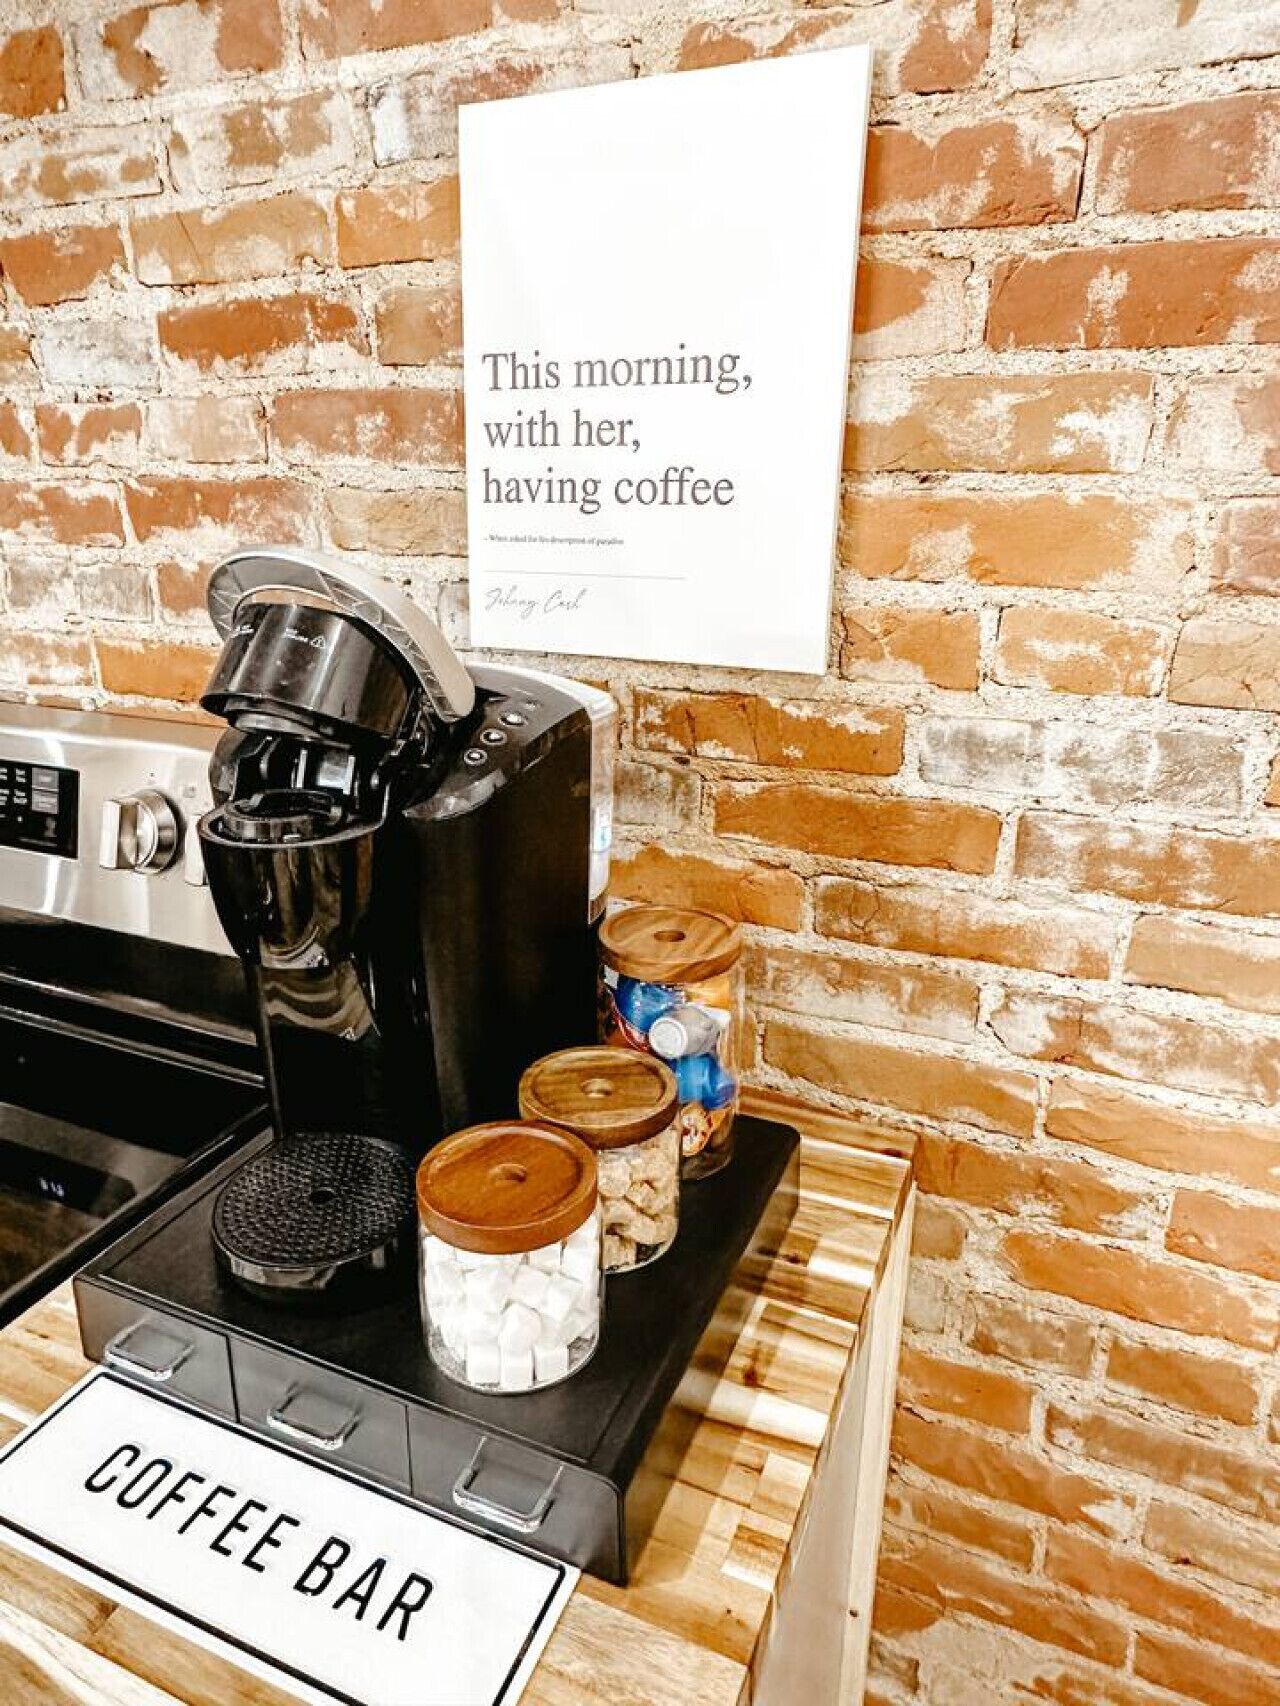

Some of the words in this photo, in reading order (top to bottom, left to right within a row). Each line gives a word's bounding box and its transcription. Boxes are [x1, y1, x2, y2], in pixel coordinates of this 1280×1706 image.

[481, 350, 561, 392] This
[573, 342, 753, 396] morning,
[483, 408, 561, 449] with
[572, 408, 641, 453] her,
[482, 466, 602, 515] having
[614, 466, 735, 506] coffee
[84, 1444, 300, 1573] COFFEE
[293, 1536, 433, 1641] BAR
